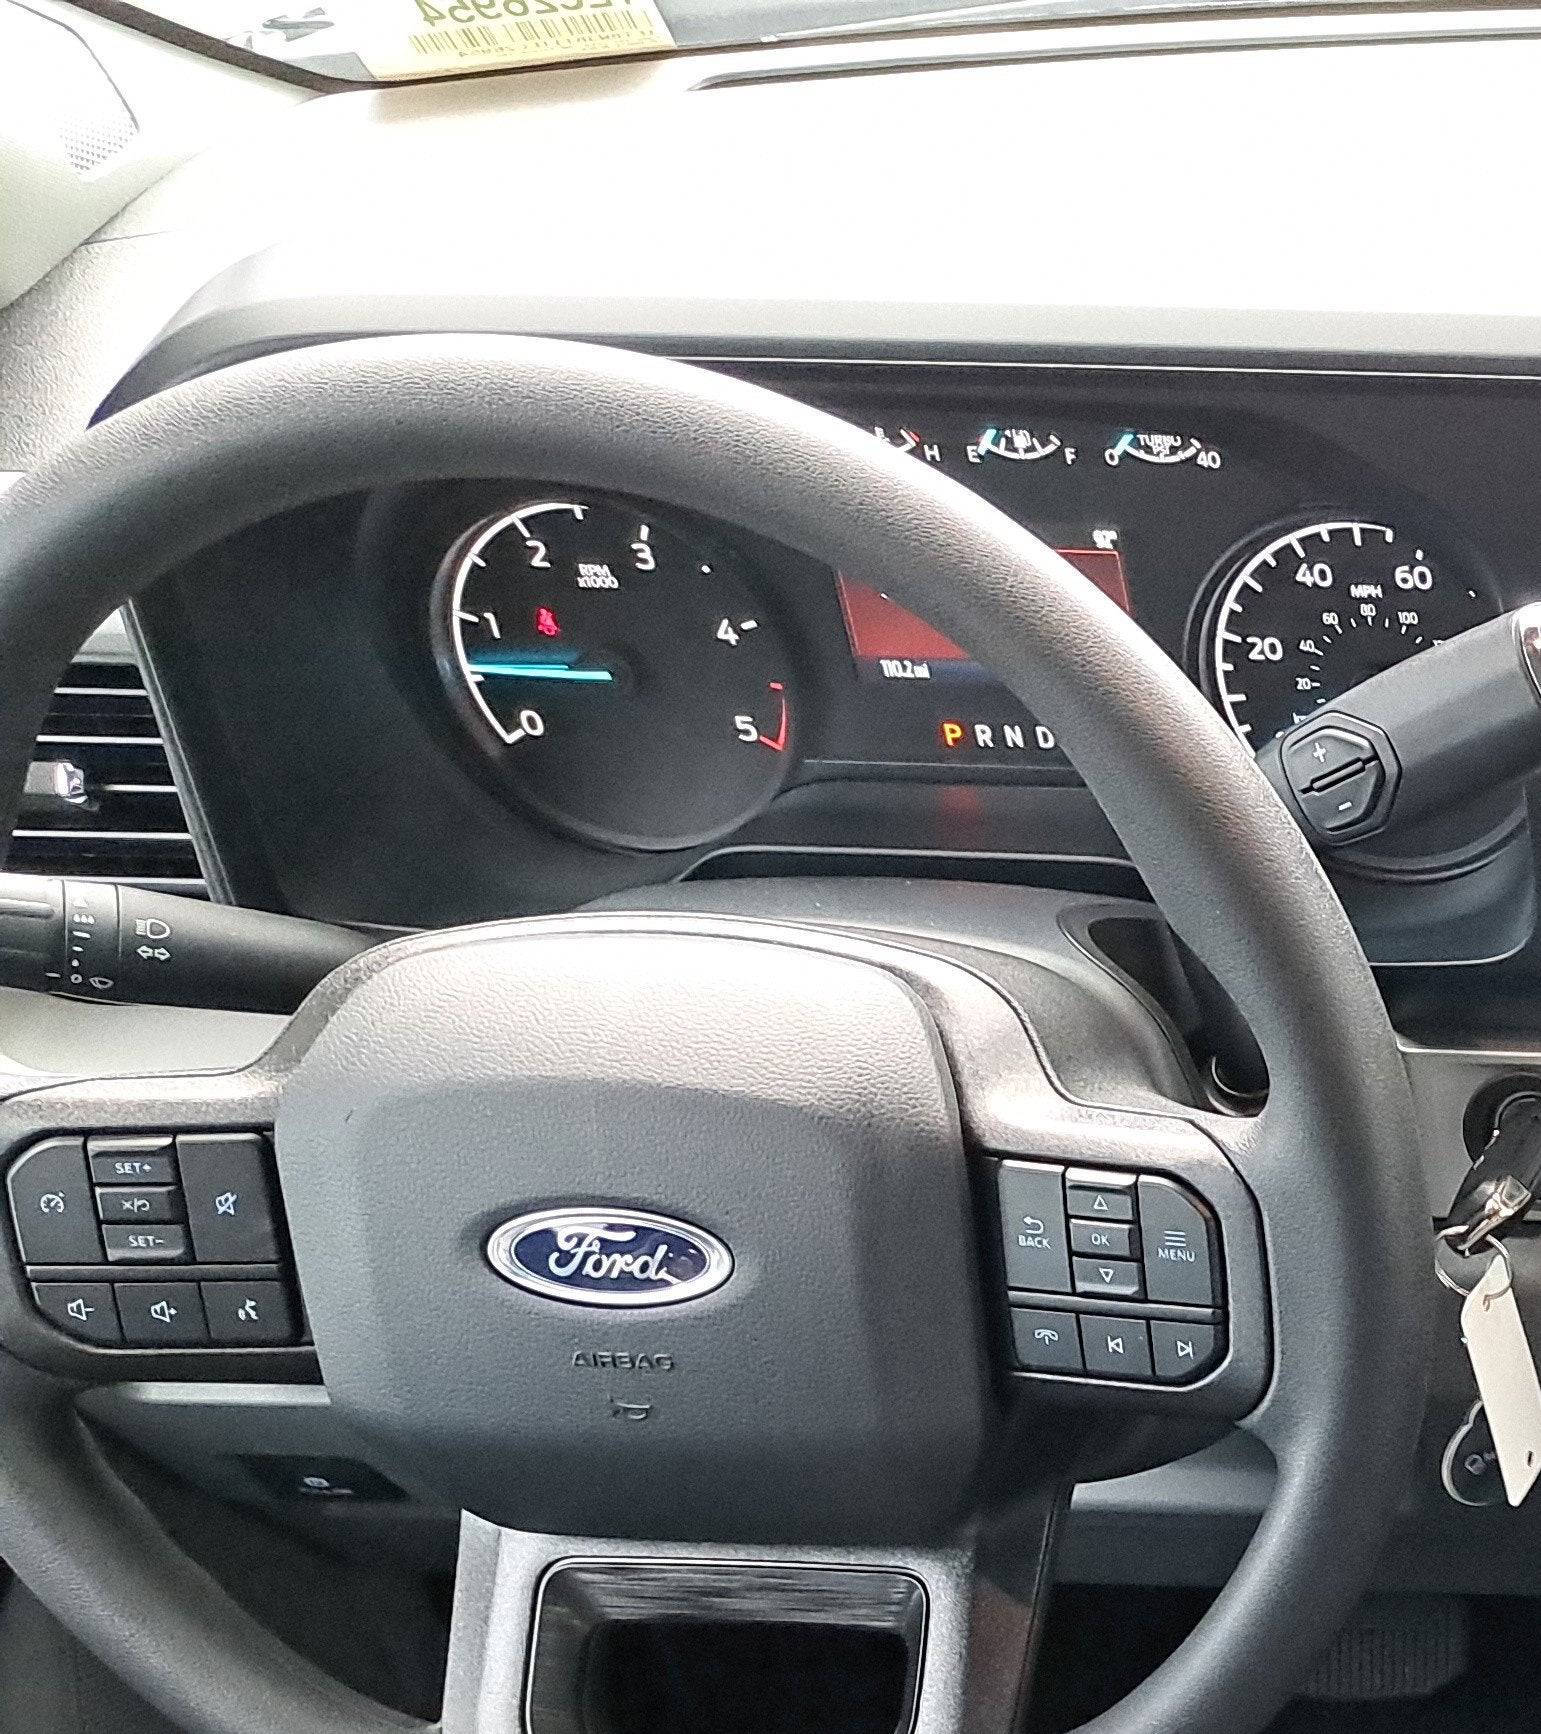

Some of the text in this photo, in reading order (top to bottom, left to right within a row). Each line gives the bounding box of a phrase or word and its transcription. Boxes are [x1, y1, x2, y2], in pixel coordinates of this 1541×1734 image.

[924, 444, 941, 462] H
[966, 445, 981, 463] E
[1065, 447, 1077, 465] F
[1196, 451, 1221, 469] 40
[525, 540, 551, 568] 2
[630, 543, 656, 571] 3
[578, 563, 611, 577] RPM
[1295, 563, 1333, 588] 40
[1395, 565, 1433, 590] 60
[1350, 584, 1383, 599] MPH
[484, 612, 501, 639] 1
[1322, 612, 1339, 625] 60
[1398, 611, 1419, 625] 100
[717, 618, 739, 645] 4
[1247, 636, 1283, 661] 20
[1299, 639, 1315, 652] 40
[1295, 677, 1311, 690] 20
[519, 710, 545, 737] 0
[735, 715, 758, 742] 5
[942, 723, 1055, 749] P R N D
[1018, 1234, 1051, 1249] BACK
[1091, 1233, 1110, 1246] OK
[547, 1223, 682, 1284] Ford
[1157, 1247, 1196, 1262] MENU
[571, 1350, 674, 1371] AIRBAG
